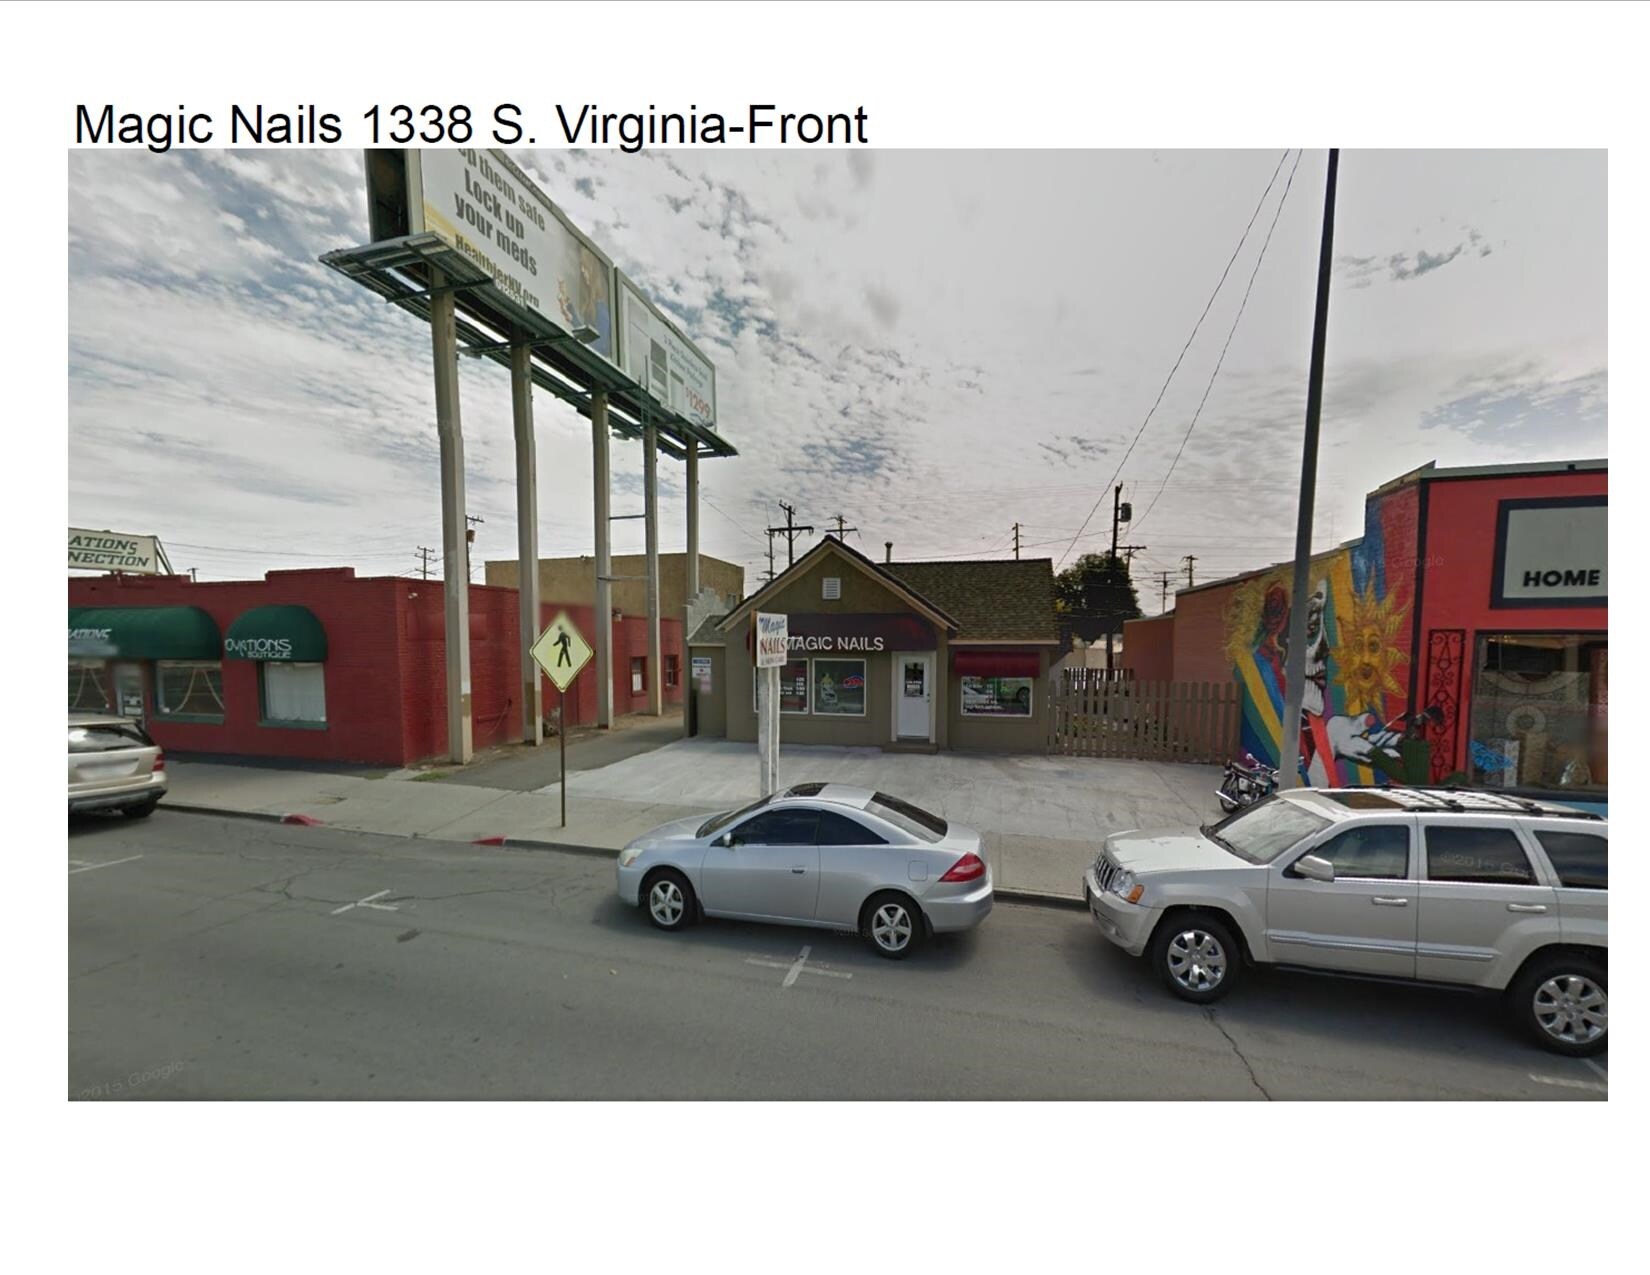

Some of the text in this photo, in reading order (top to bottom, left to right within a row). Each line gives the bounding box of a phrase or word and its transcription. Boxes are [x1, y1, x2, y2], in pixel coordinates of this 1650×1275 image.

[479, 155, 516, 206] them
[517, 194, 545, 231] safe
[464, 167, 503, 223] Lock
[505, 209, 525, 240] up
[454, 192, 537, 276] your meds
[1523, 569, 1601, 588] HOME
[759, 617, 785, 634] Magic
[760, 638, 786, 655] NAILS
[837, 636, 884, 651] NAILS
